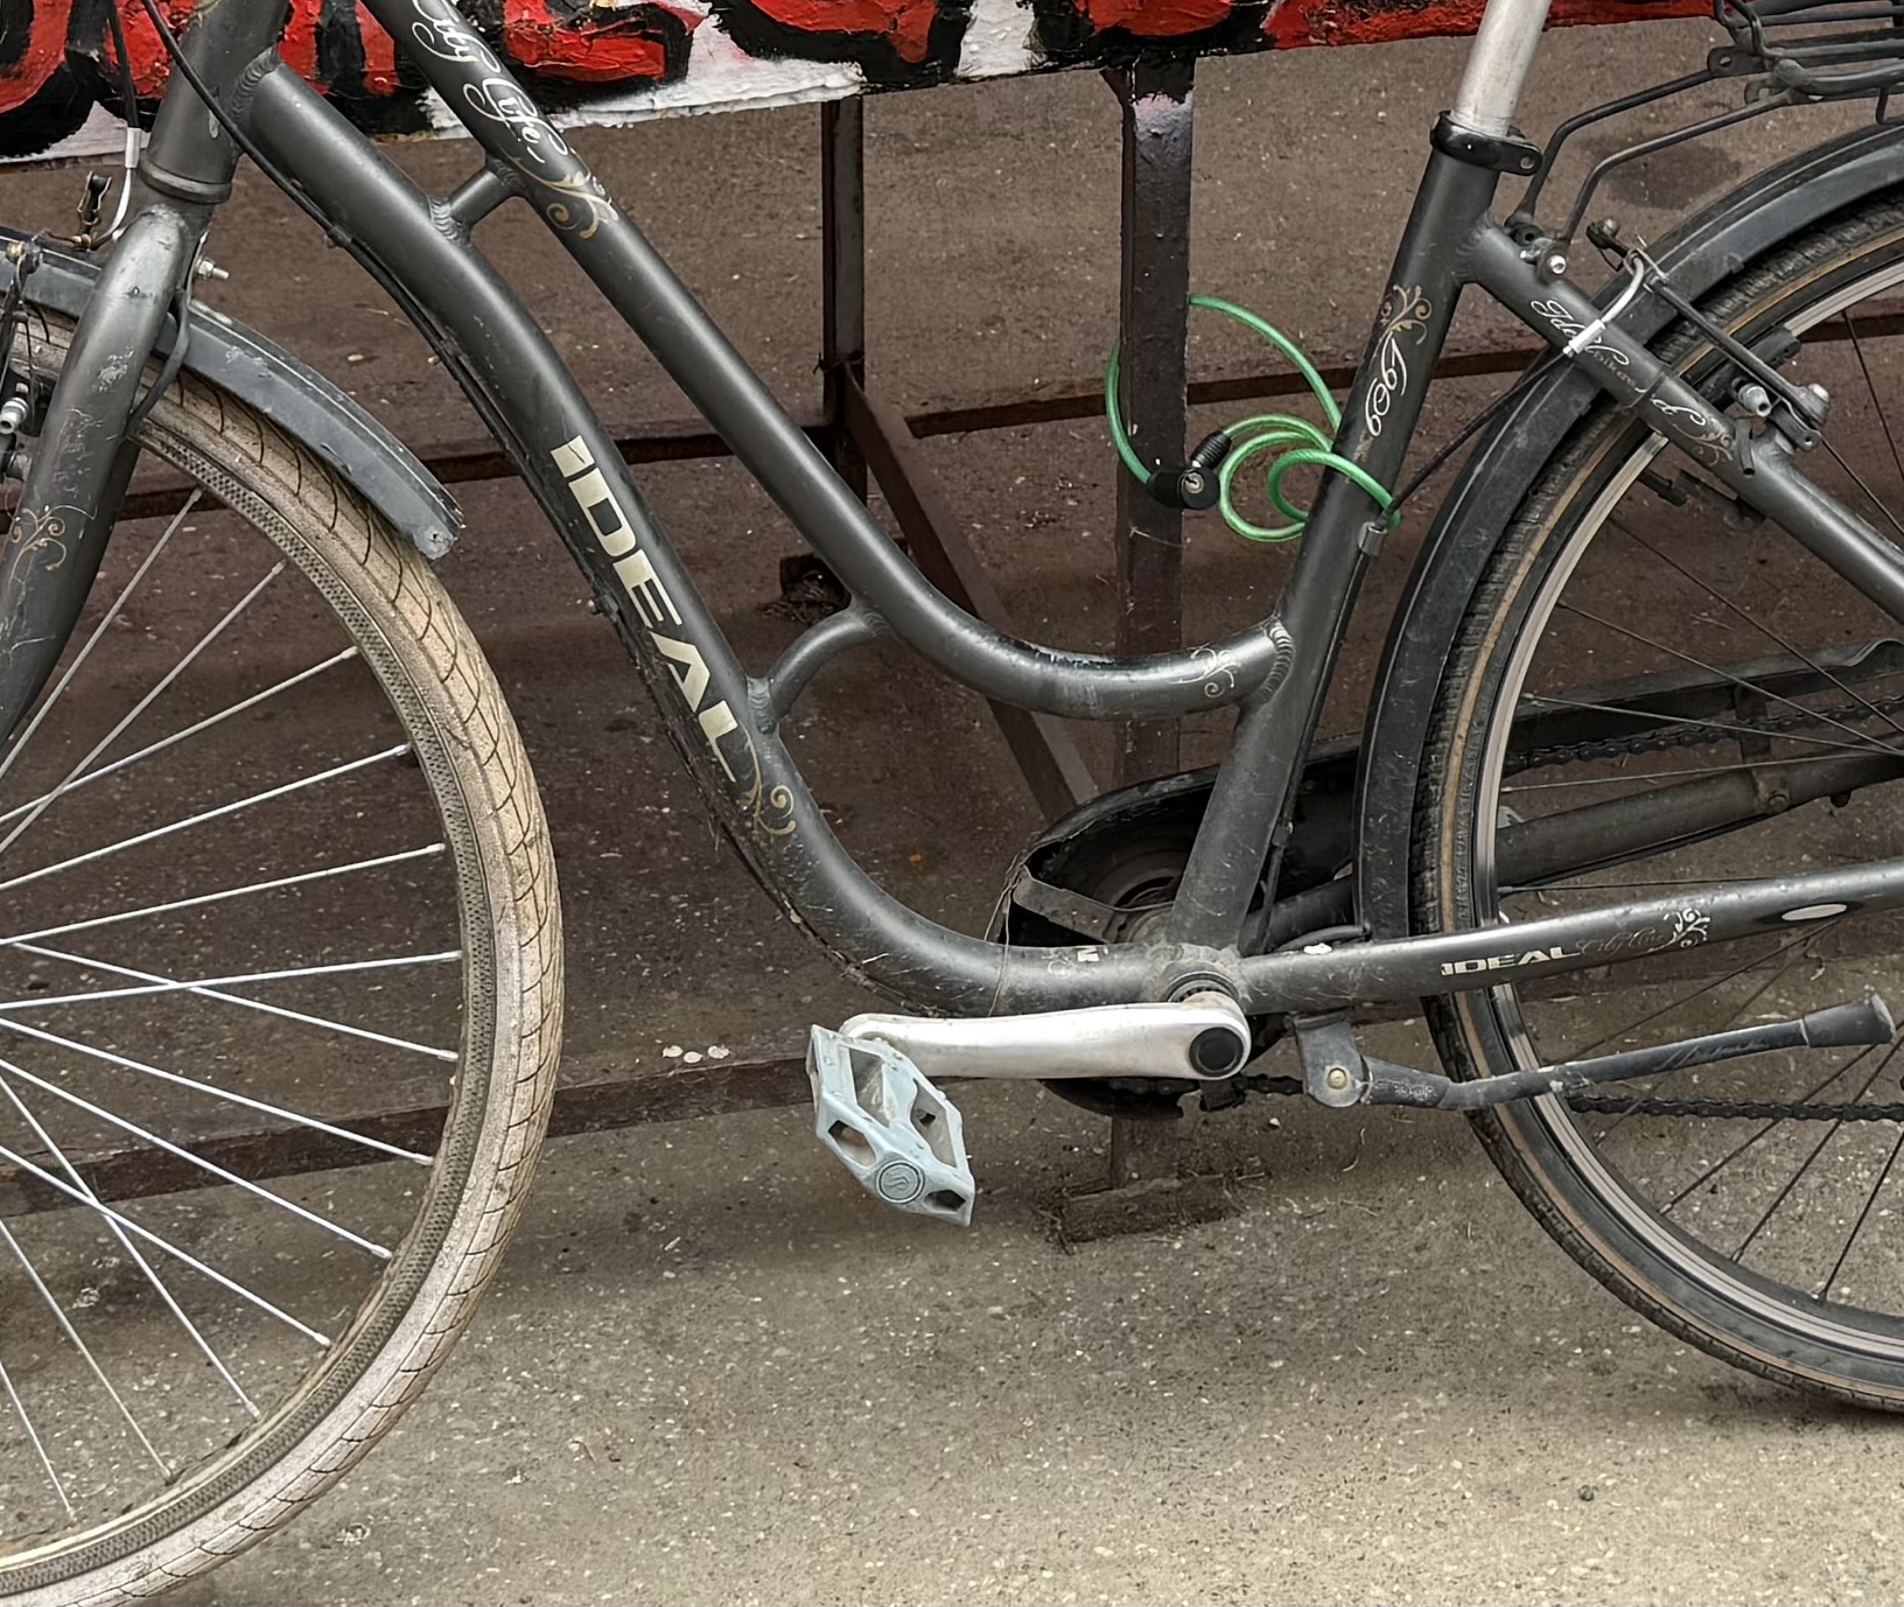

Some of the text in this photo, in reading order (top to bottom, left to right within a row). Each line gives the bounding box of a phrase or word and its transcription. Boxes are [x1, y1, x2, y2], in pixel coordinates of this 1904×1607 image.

[462, 77, 568, 163] Life
[549, 435, 748, 784] IDEAL
[1440, 945, 1582, 977] IDEAL
